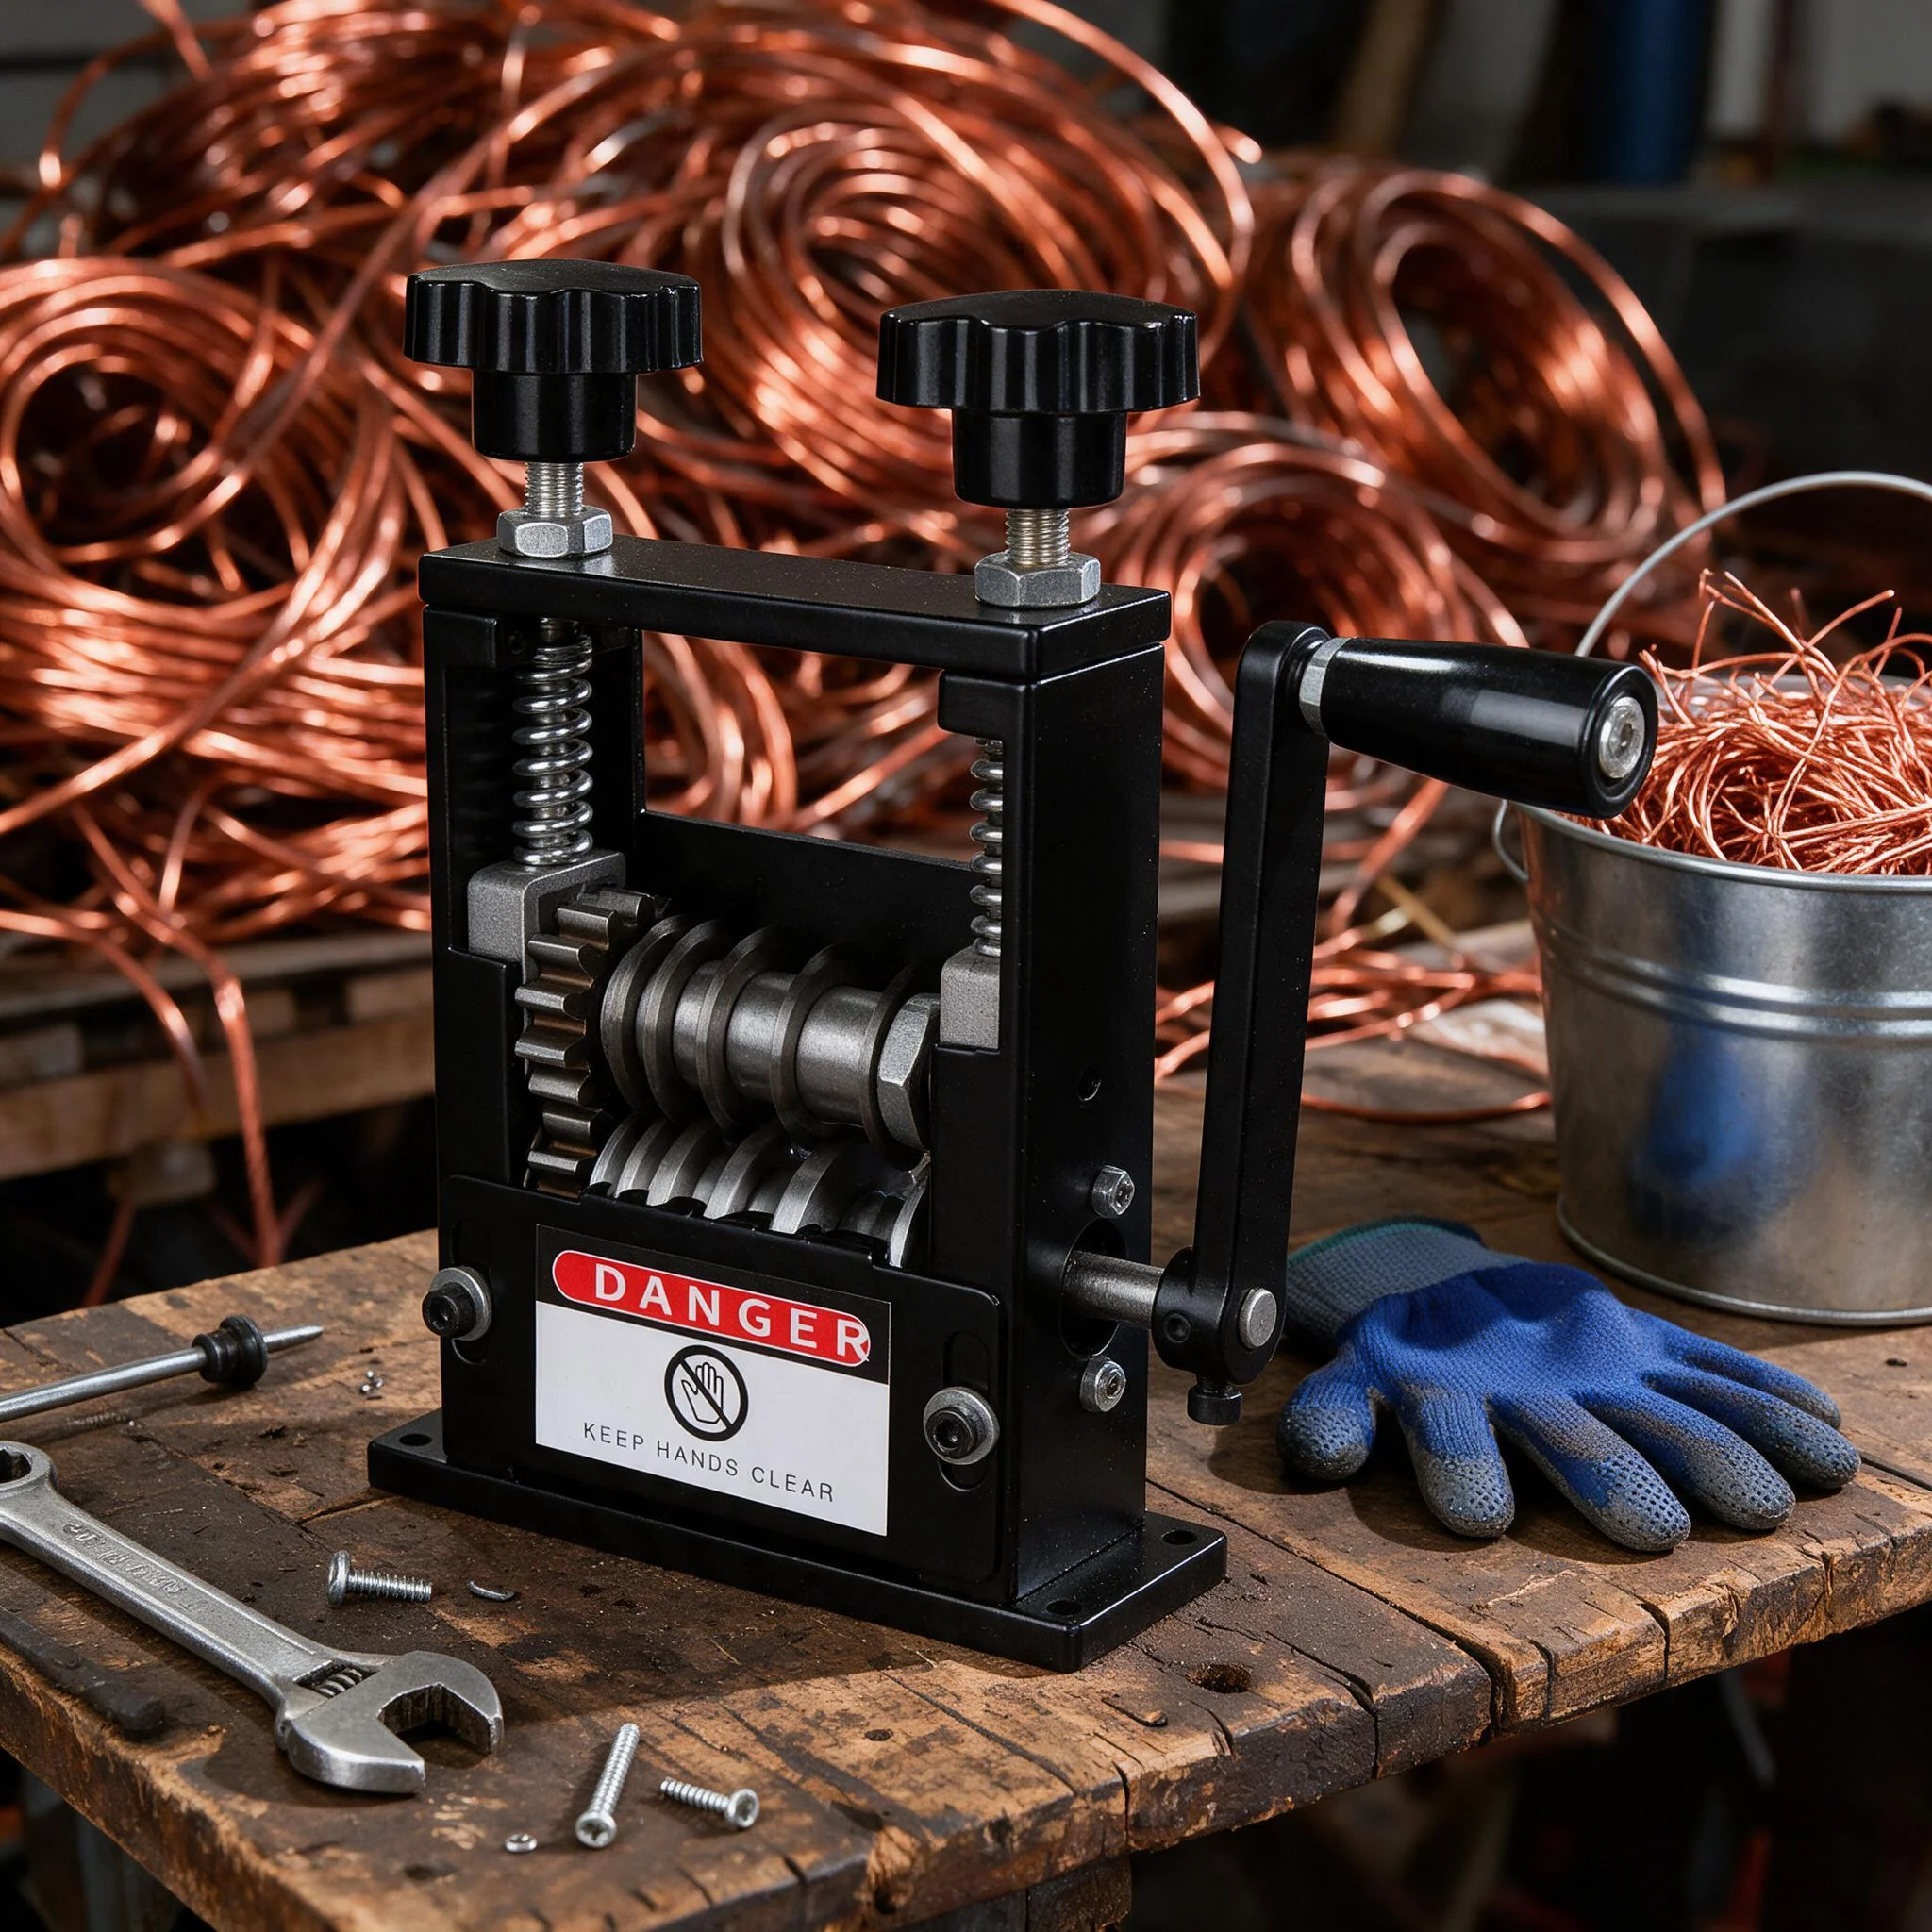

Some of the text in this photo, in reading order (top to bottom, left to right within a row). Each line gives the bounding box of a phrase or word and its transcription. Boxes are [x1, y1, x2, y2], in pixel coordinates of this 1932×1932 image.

[595, 1263, 871, 1362] DANGER
[583, 1422, 834, 1503] KEEP HANDS CLEAR
